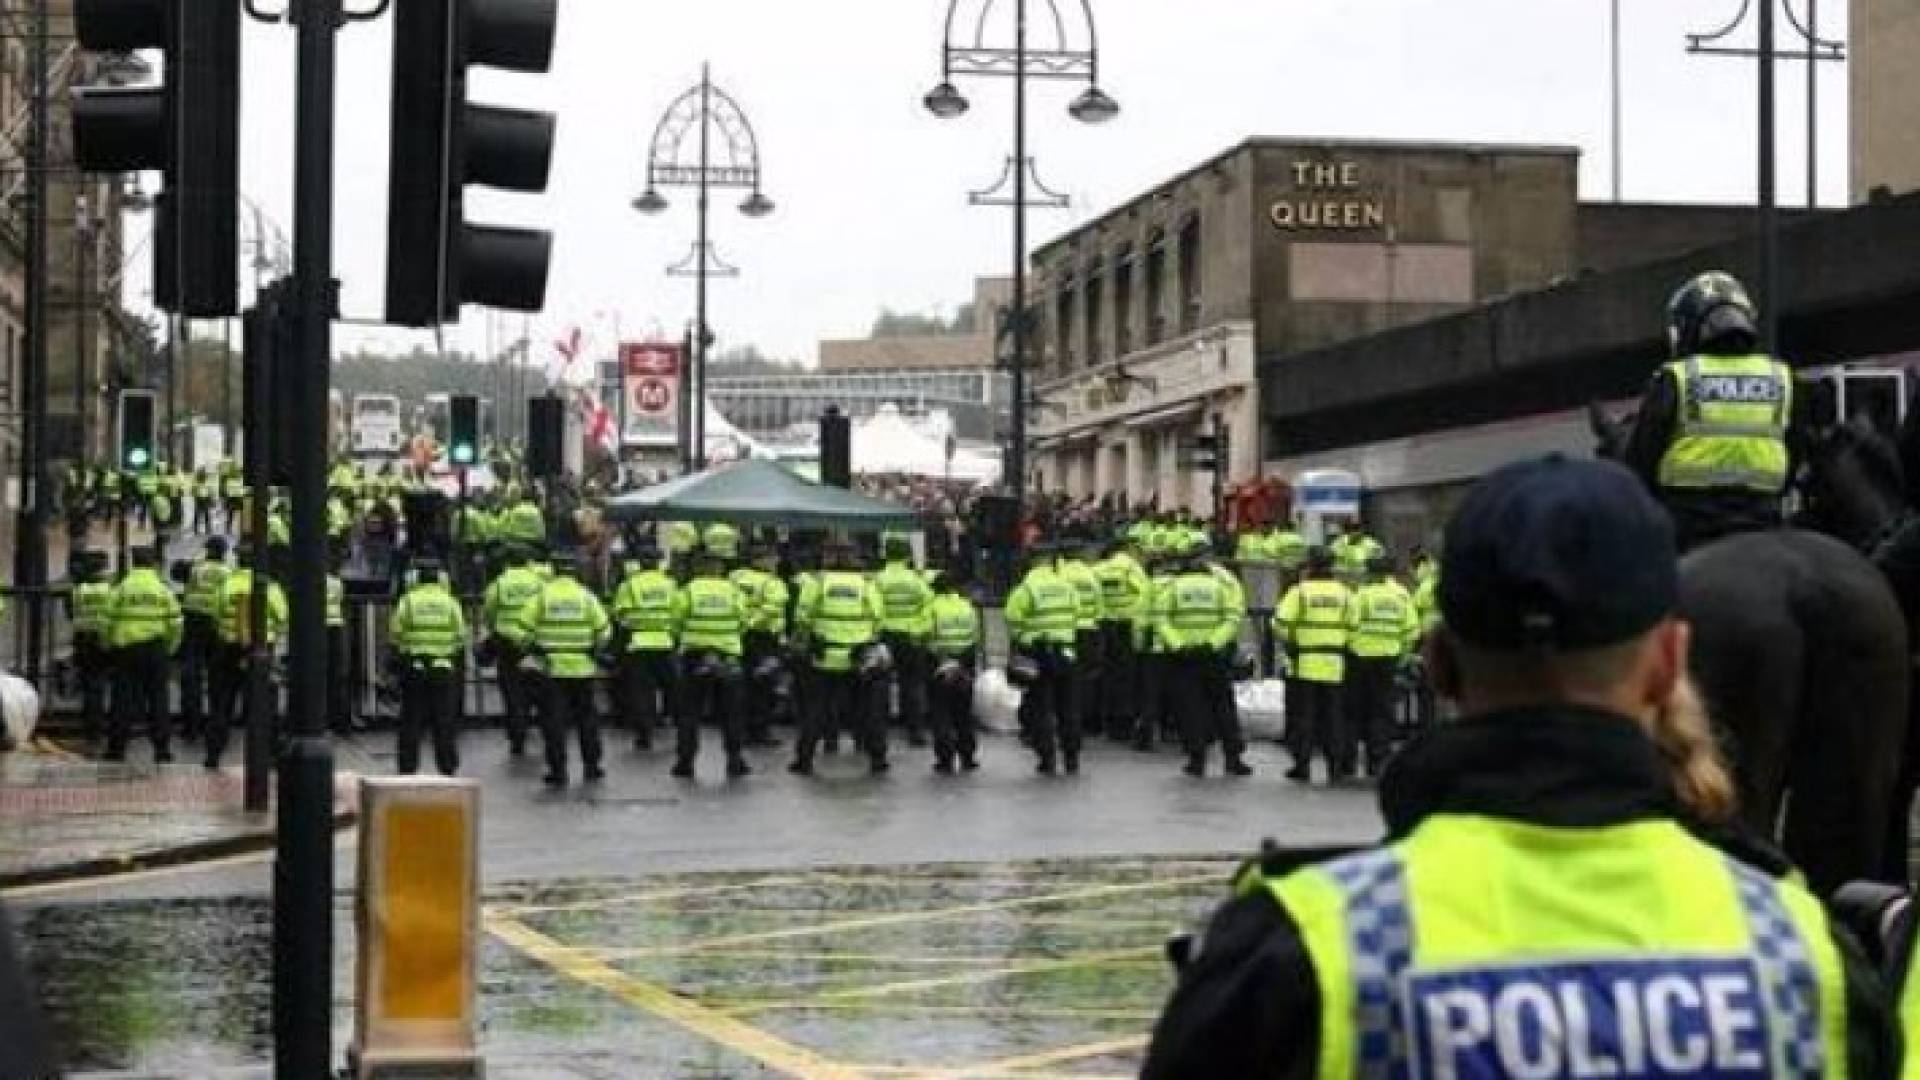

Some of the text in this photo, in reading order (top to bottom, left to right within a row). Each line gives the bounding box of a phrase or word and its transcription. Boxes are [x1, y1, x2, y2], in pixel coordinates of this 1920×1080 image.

[1291, 160, 1359, 186] THE
[1270, 201, 1384, 226] QUEEN
[640, 386, 666, 404] M
[1698, 376, 1777, 401] POLICE
[1424, 974, 1764, 1080] POLICE
